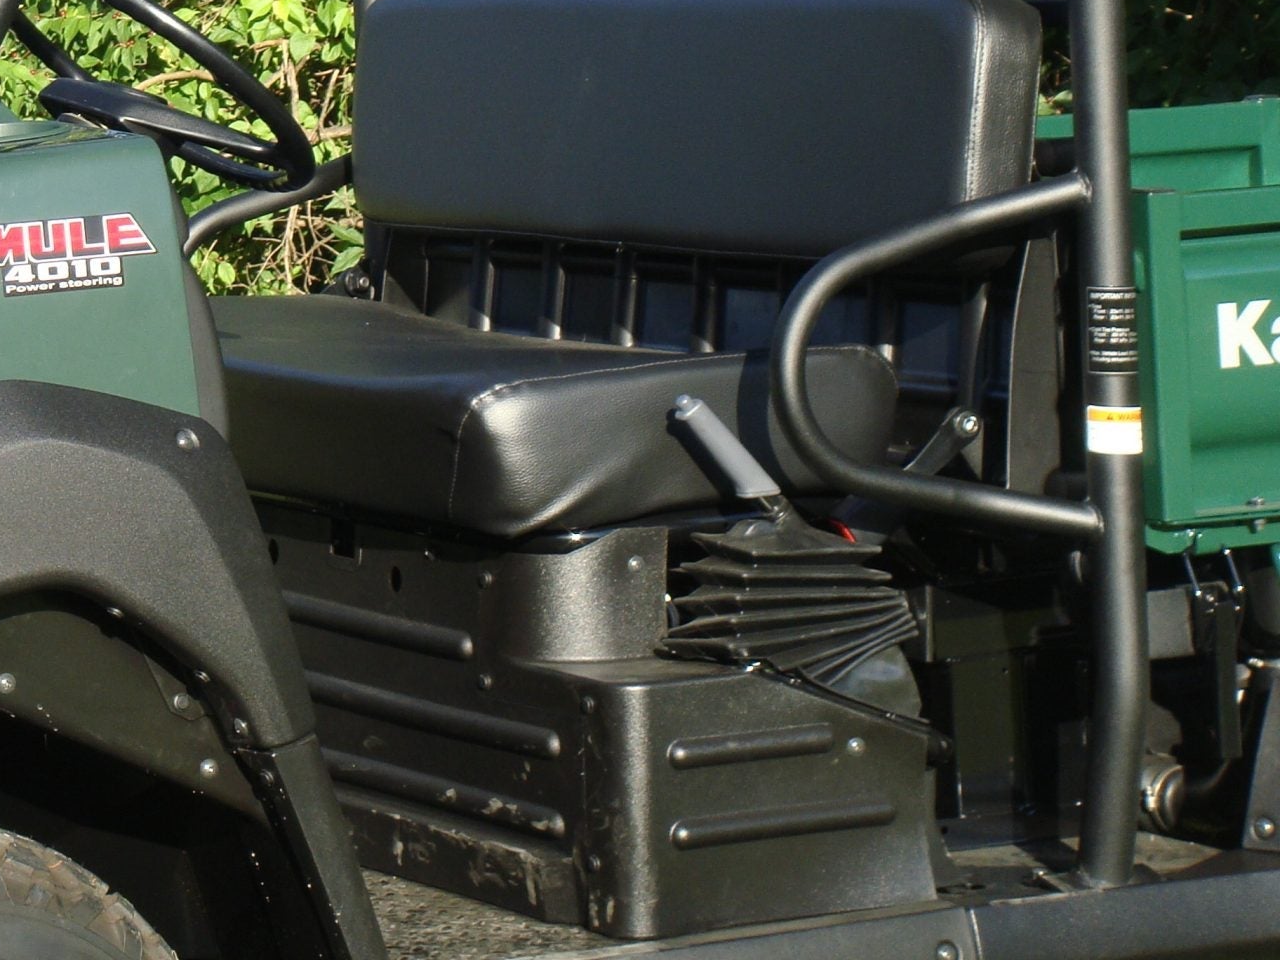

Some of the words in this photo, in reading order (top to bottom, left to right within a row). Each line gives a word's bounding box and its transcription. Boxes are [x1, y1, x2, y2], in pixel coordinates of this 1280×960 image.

[5, 257, 122, 282] 4010
[5, 282, 56, 294] Power
[59, 276, 123, 289] steering
